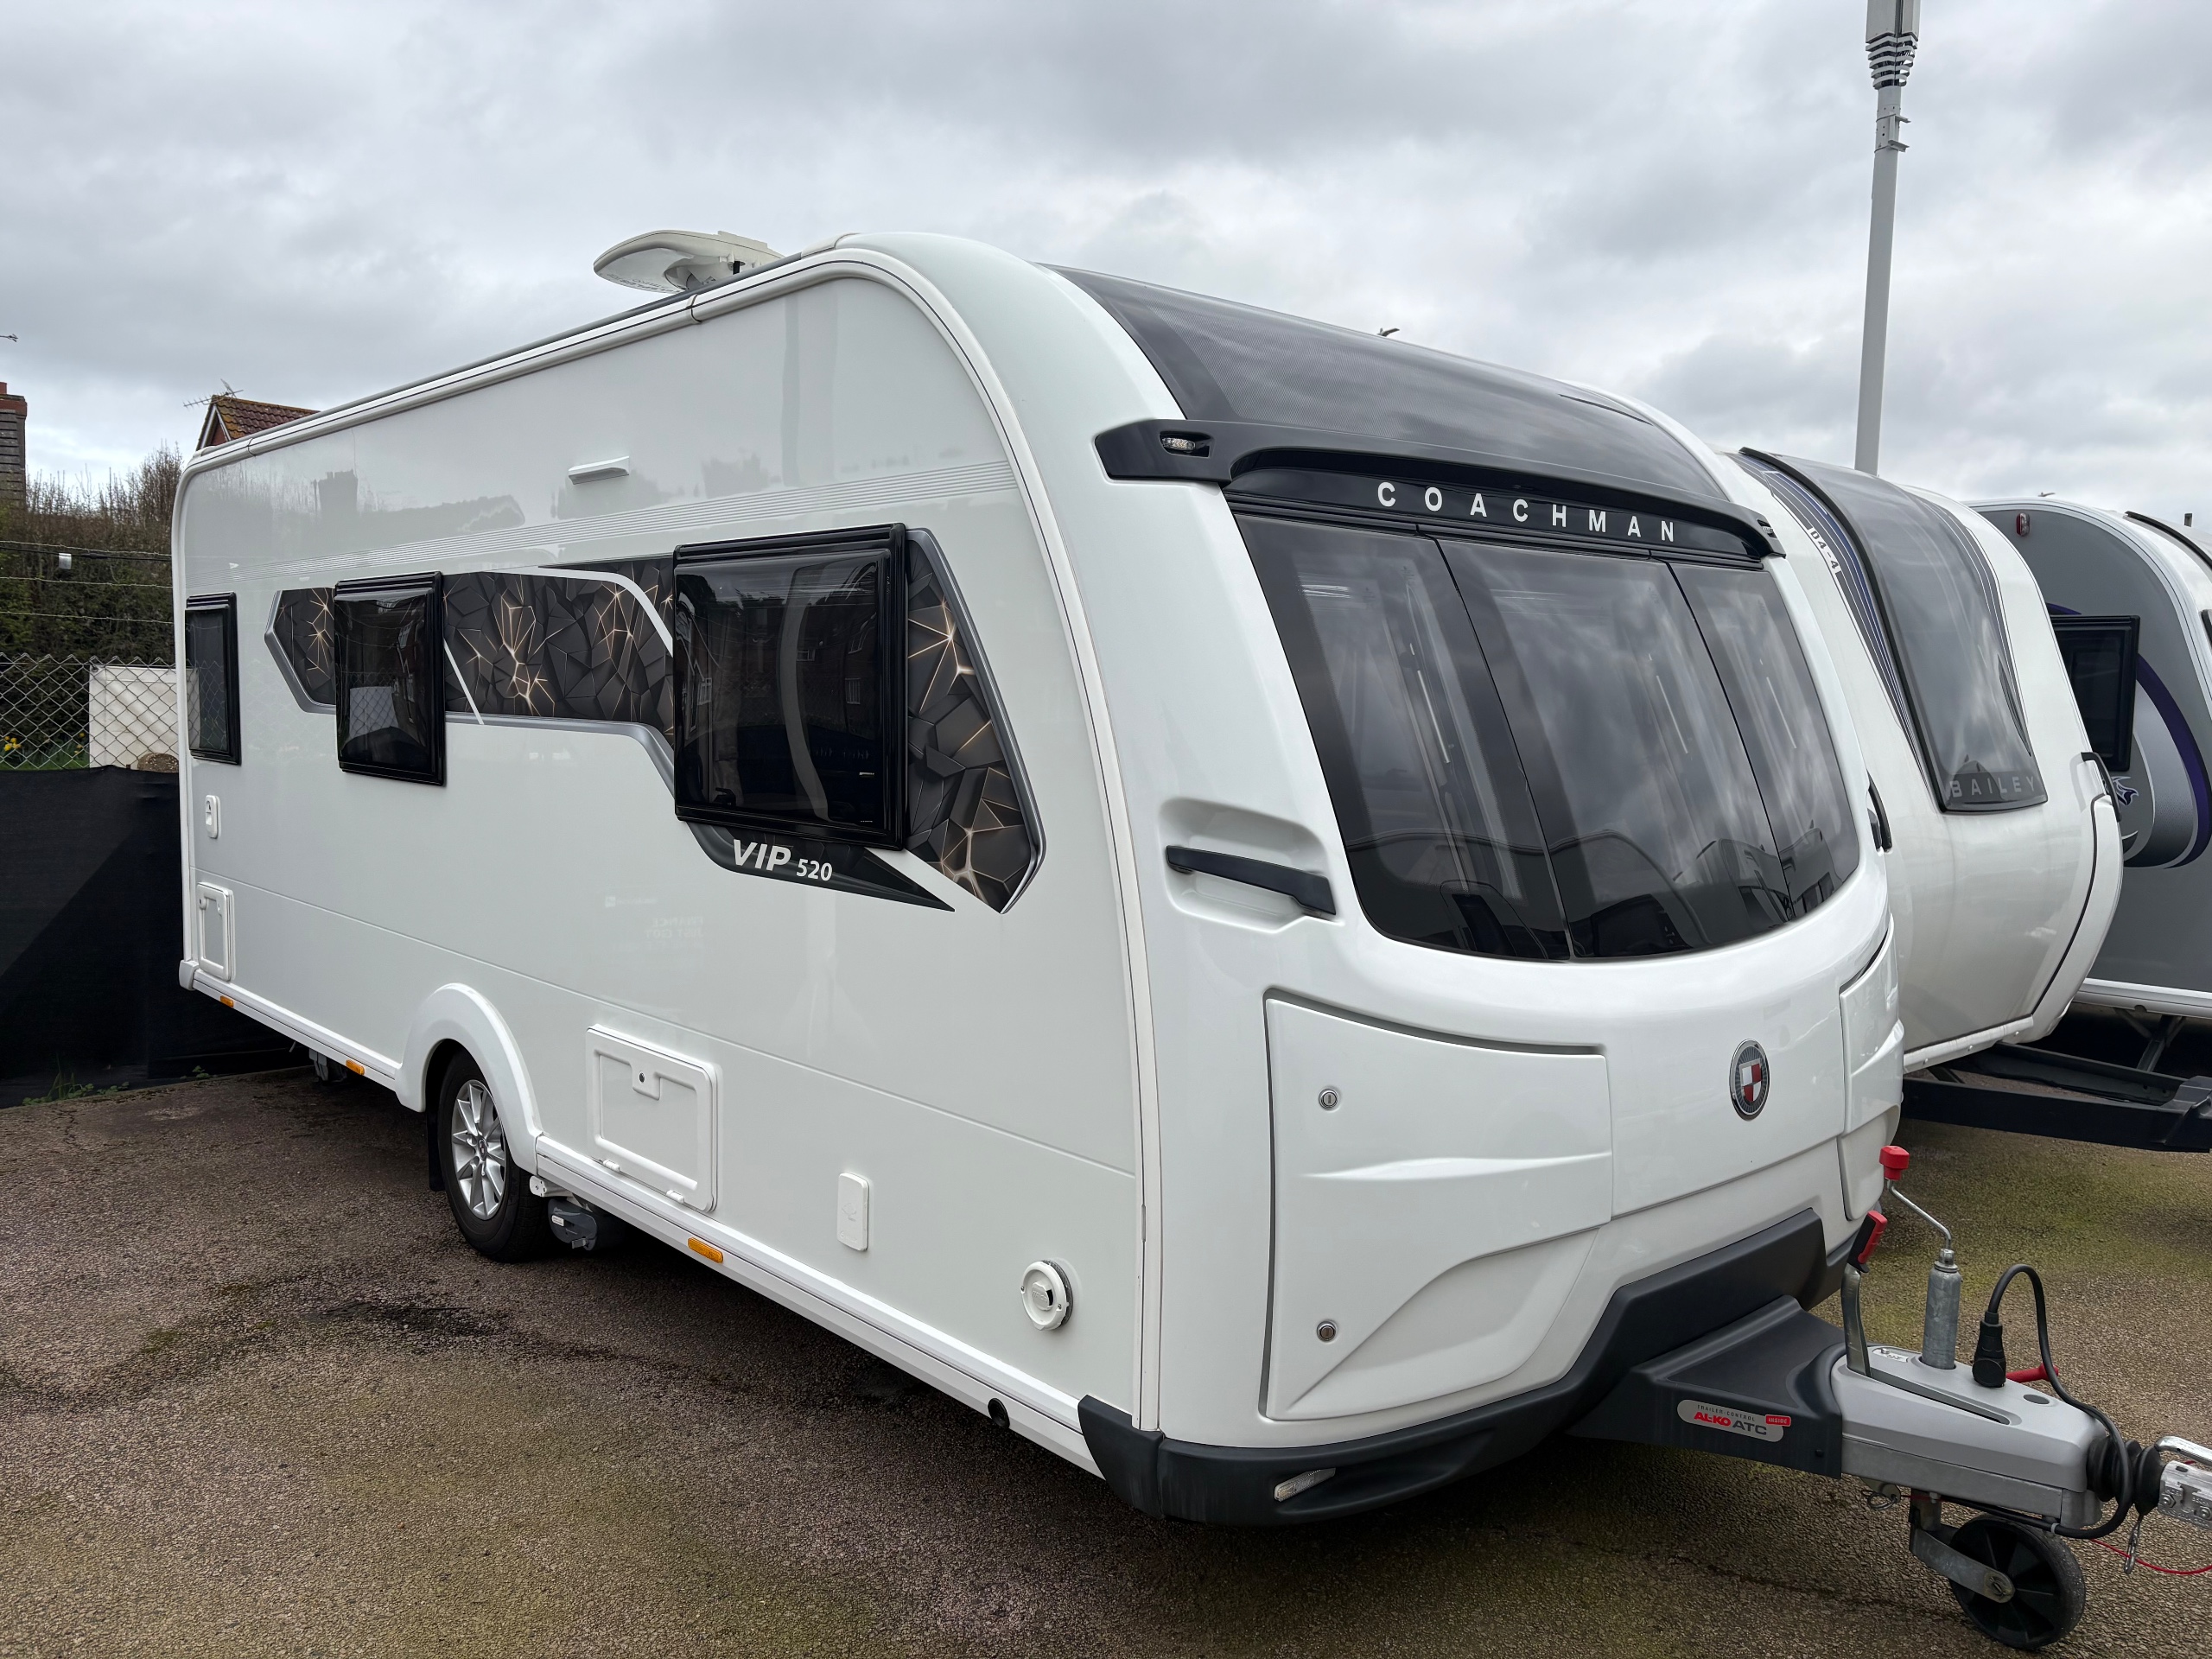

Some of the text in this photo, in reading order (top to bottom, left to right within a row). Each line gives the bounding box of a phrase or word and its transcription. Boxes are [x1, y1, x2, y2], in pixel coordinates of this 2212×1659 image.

[1377, 481, 1675, 543] COACHMAN
[1948, 775, 2036, 798] BAILEY
[733, 838, 833, 881] VIP 520
[1694, 1411, 1767, 1435] AL-KO ATC
